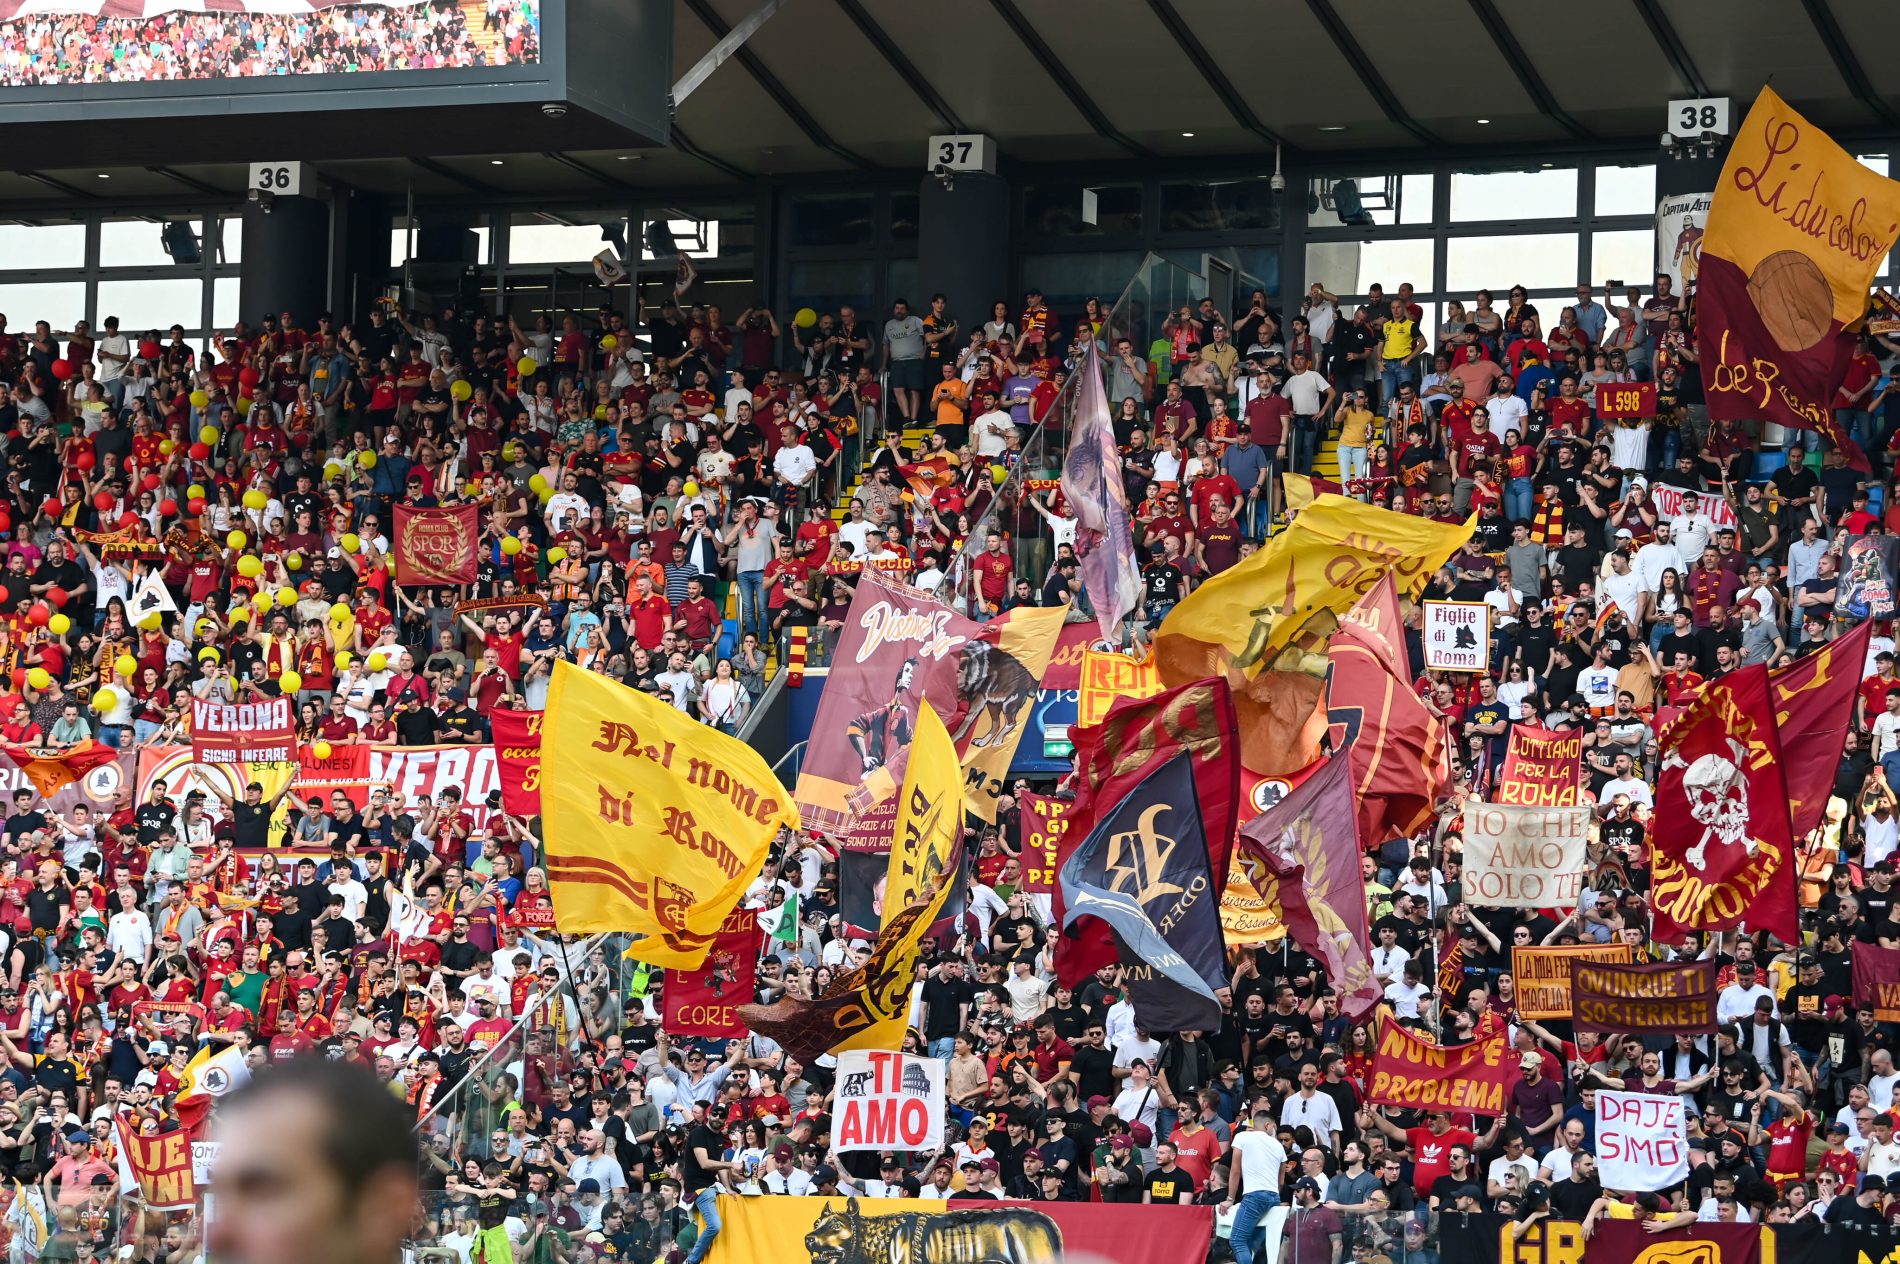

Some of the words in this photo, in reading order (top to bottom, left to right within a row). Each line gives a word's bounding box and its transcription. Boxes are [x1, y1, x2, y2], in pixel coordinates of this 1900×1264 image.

[1680, 106, 1717, 129] 38
[939, 142, 973, 164] 37
[259, 168, 290, 189] 36
[1662, 201, 1690, 217] CAPITAN
[1603, 394, 1612, 412] L
[1615, 391, 1640, 412] 598
[1466, 443, 1485, 452] QATAR
[418, 525, 434, 533] ROMA
[435, 525, 448, 533] CLUB
[413, 535, 456, 555] SPQR
[831, 558, 912, 572] TESTCCIO
[1435, 607, 1476, 626] Figlie
[1434, 630, 1446, 642] di
[1433, 650, 1476, 666] Roma
[194, 698, 288, 732] VERONA
[202, 748, 237, 763] SIGNA
[241, 747, 288, 763] INFERRE
[1510, 735, 1580, 760] LOTTIAMO
[330, 777, 356, 785] SUD
[357, 777, 388, 785] ROMA
[591, 720, 677, 770] Nel
[686, 757, 779, 826] nome
[1514, 763, 1544, 778] PER
[1550, 765, 1570, 778] LA
[1502, 781, 1575, 807] ROMA
[598, 784, 634, 826] di
[142, 819, 161, 829] SPQR
[1473, 809, 1507, 837] IO
[1517, 811, 1582, 838] CHE
[868, 836, 878, 847] DI
[1488, 841, 1564, 869] AMO
[1464, 870, 1544, 900] SOLO
[1553, 872, 1581, 899] TE
[1222, 895, 1265, 907] sistenz
[1518, 955, 1533, 980] LA
[1535, 955, 1553, 981] MIA
[1578, 968, 1678, 998] OVUNQUE
[1681, 968, 1705, 994] TI
[148, 1003, 191, 1012] TRENTINO
[1521, 987, 1565, 1013] MAGLIA
[678, 1005, 735, 1026] CORE
[1380, 1029, 1446, 1068] NUN
[868, 1051, 903, 1094] TI
[1371, 1071, 1504, 1111] PROBLEMA
[986, 1112, 1008, 1132] 32
[1600, 1095, 1680, 1128] DAJE
[840, 1098, 929, 1147] AMO
[1600, 1131, 1680, 1167] SIMÒ
[81, 1219, 109, 1230] SD
